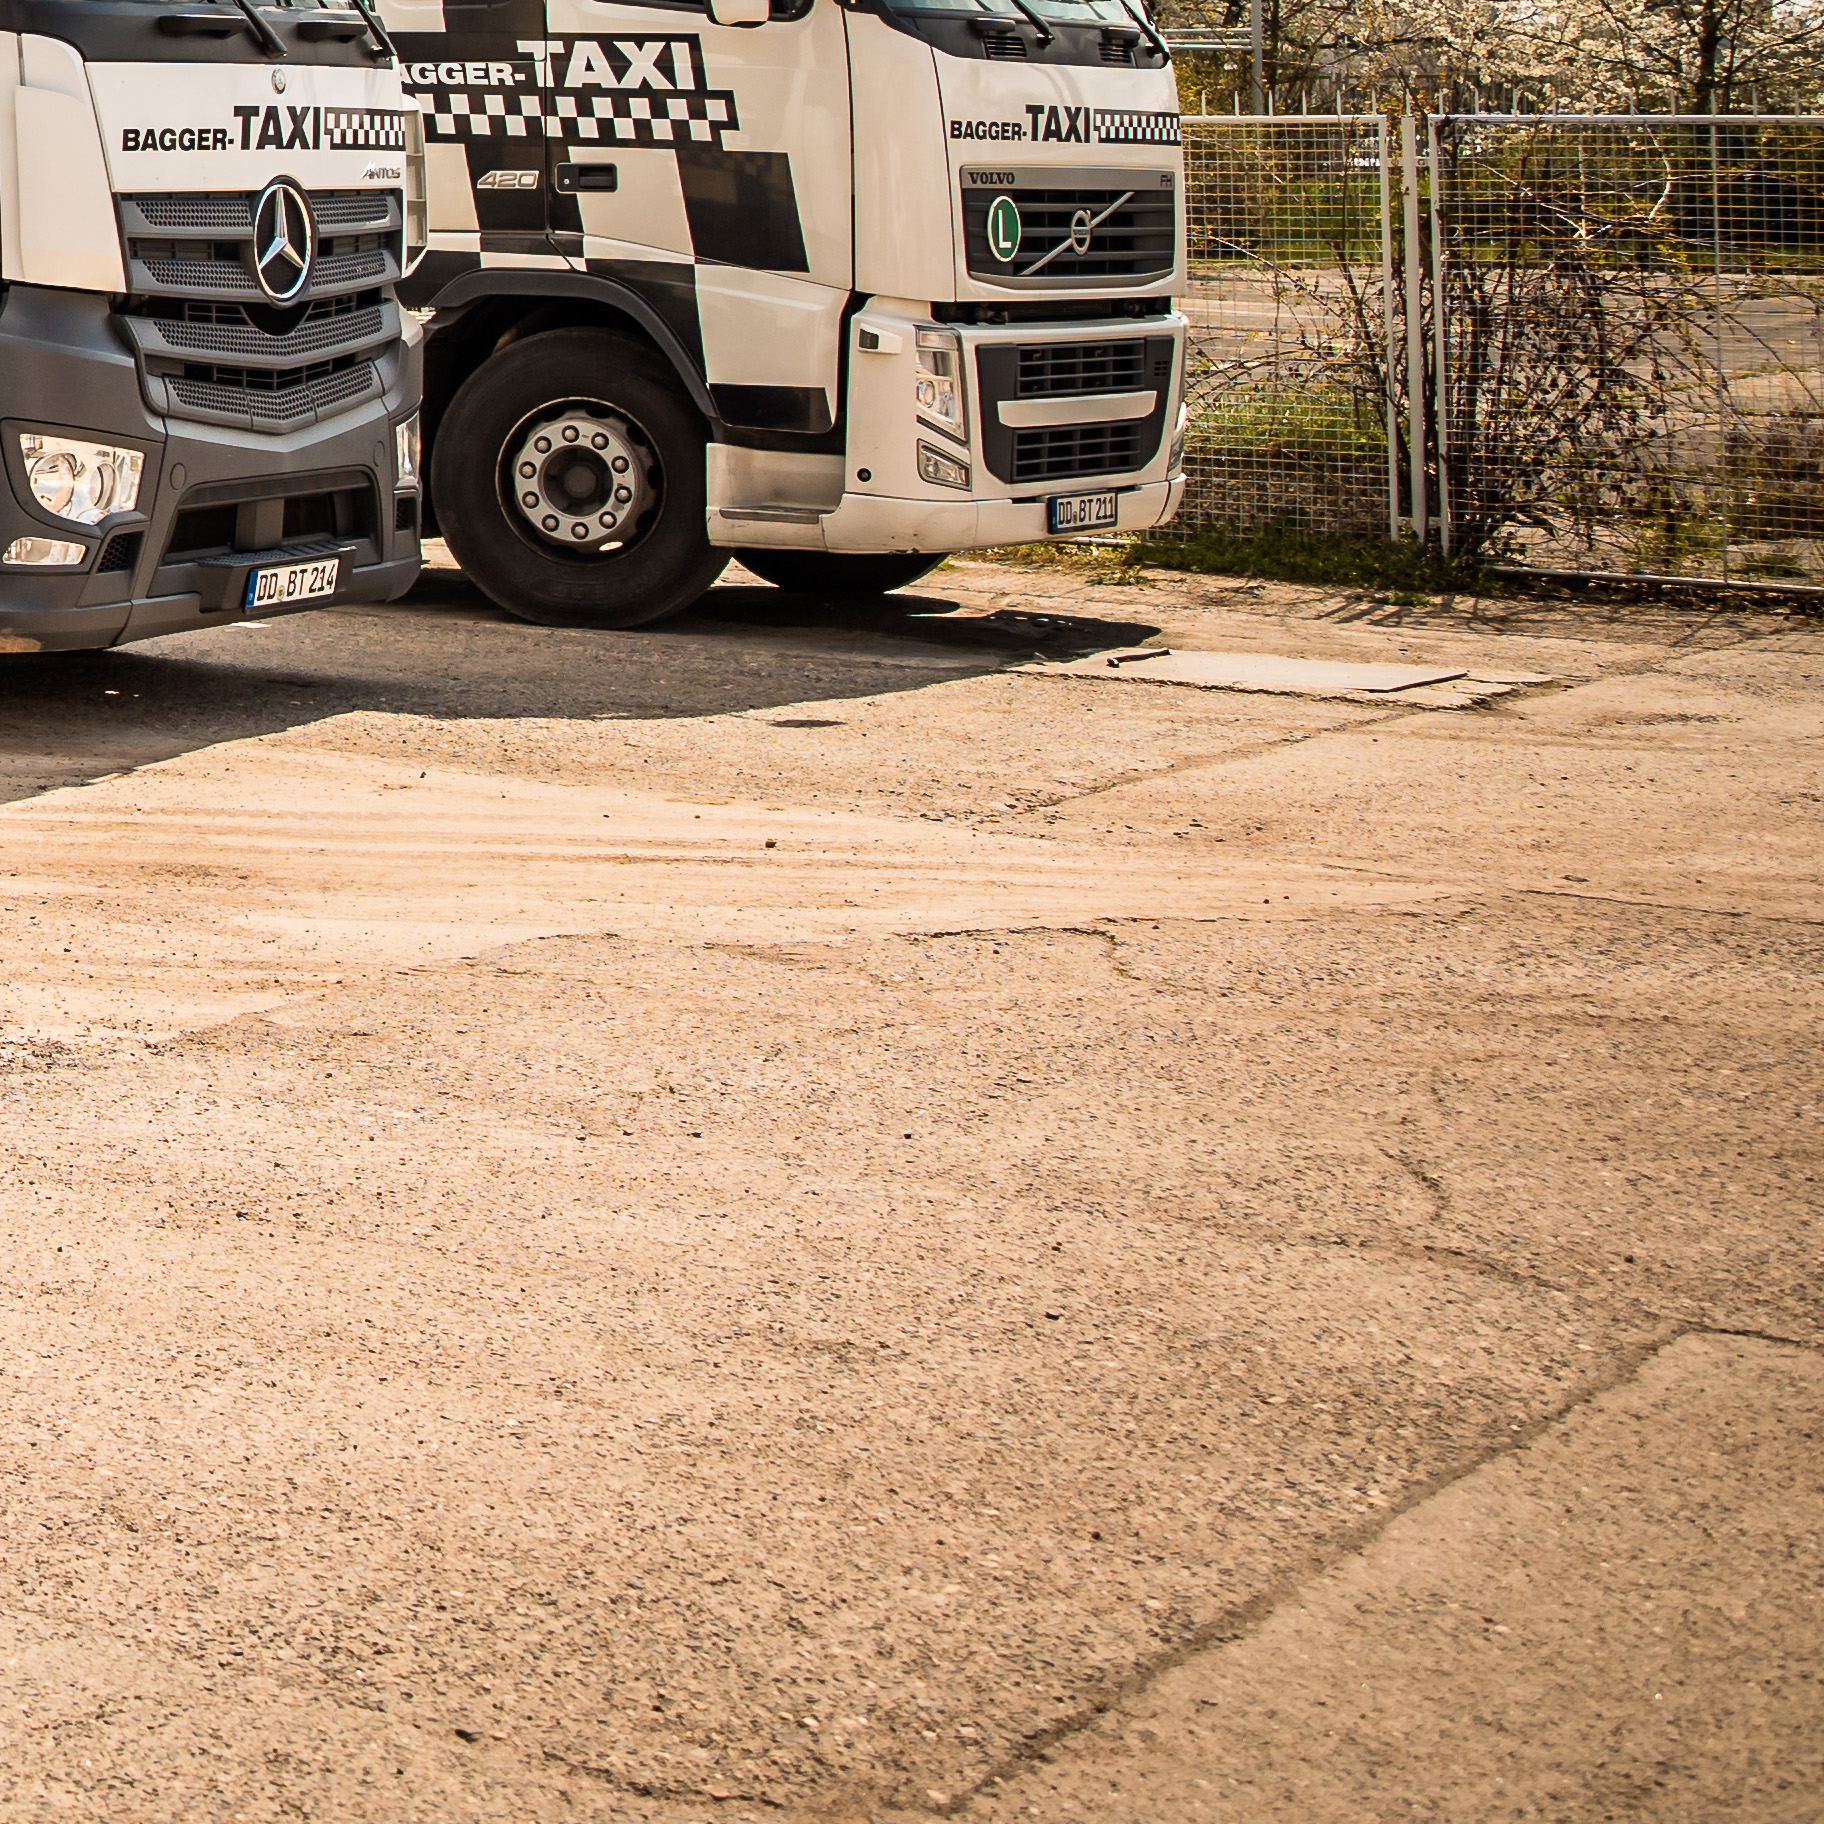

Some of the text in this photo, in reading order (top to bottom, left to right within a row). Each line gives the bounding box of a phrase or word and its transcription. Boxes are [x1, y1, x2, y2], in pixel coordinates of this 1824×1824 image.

[398, 40, 696, 90] AGGER-TAXI
[122, 105, 321, 152] BAGGER-TAXI
[950, 104, 1091, 143] BAGGER-TAXI
[478, 172, 537, 187] 420
[968, 171, 1016, 185] VOLVO
[998, 209, 1012, 249] L
[1058, 496, 1114, 525] DD BT 211
[256, 563, 336, 602] DD BT 214
